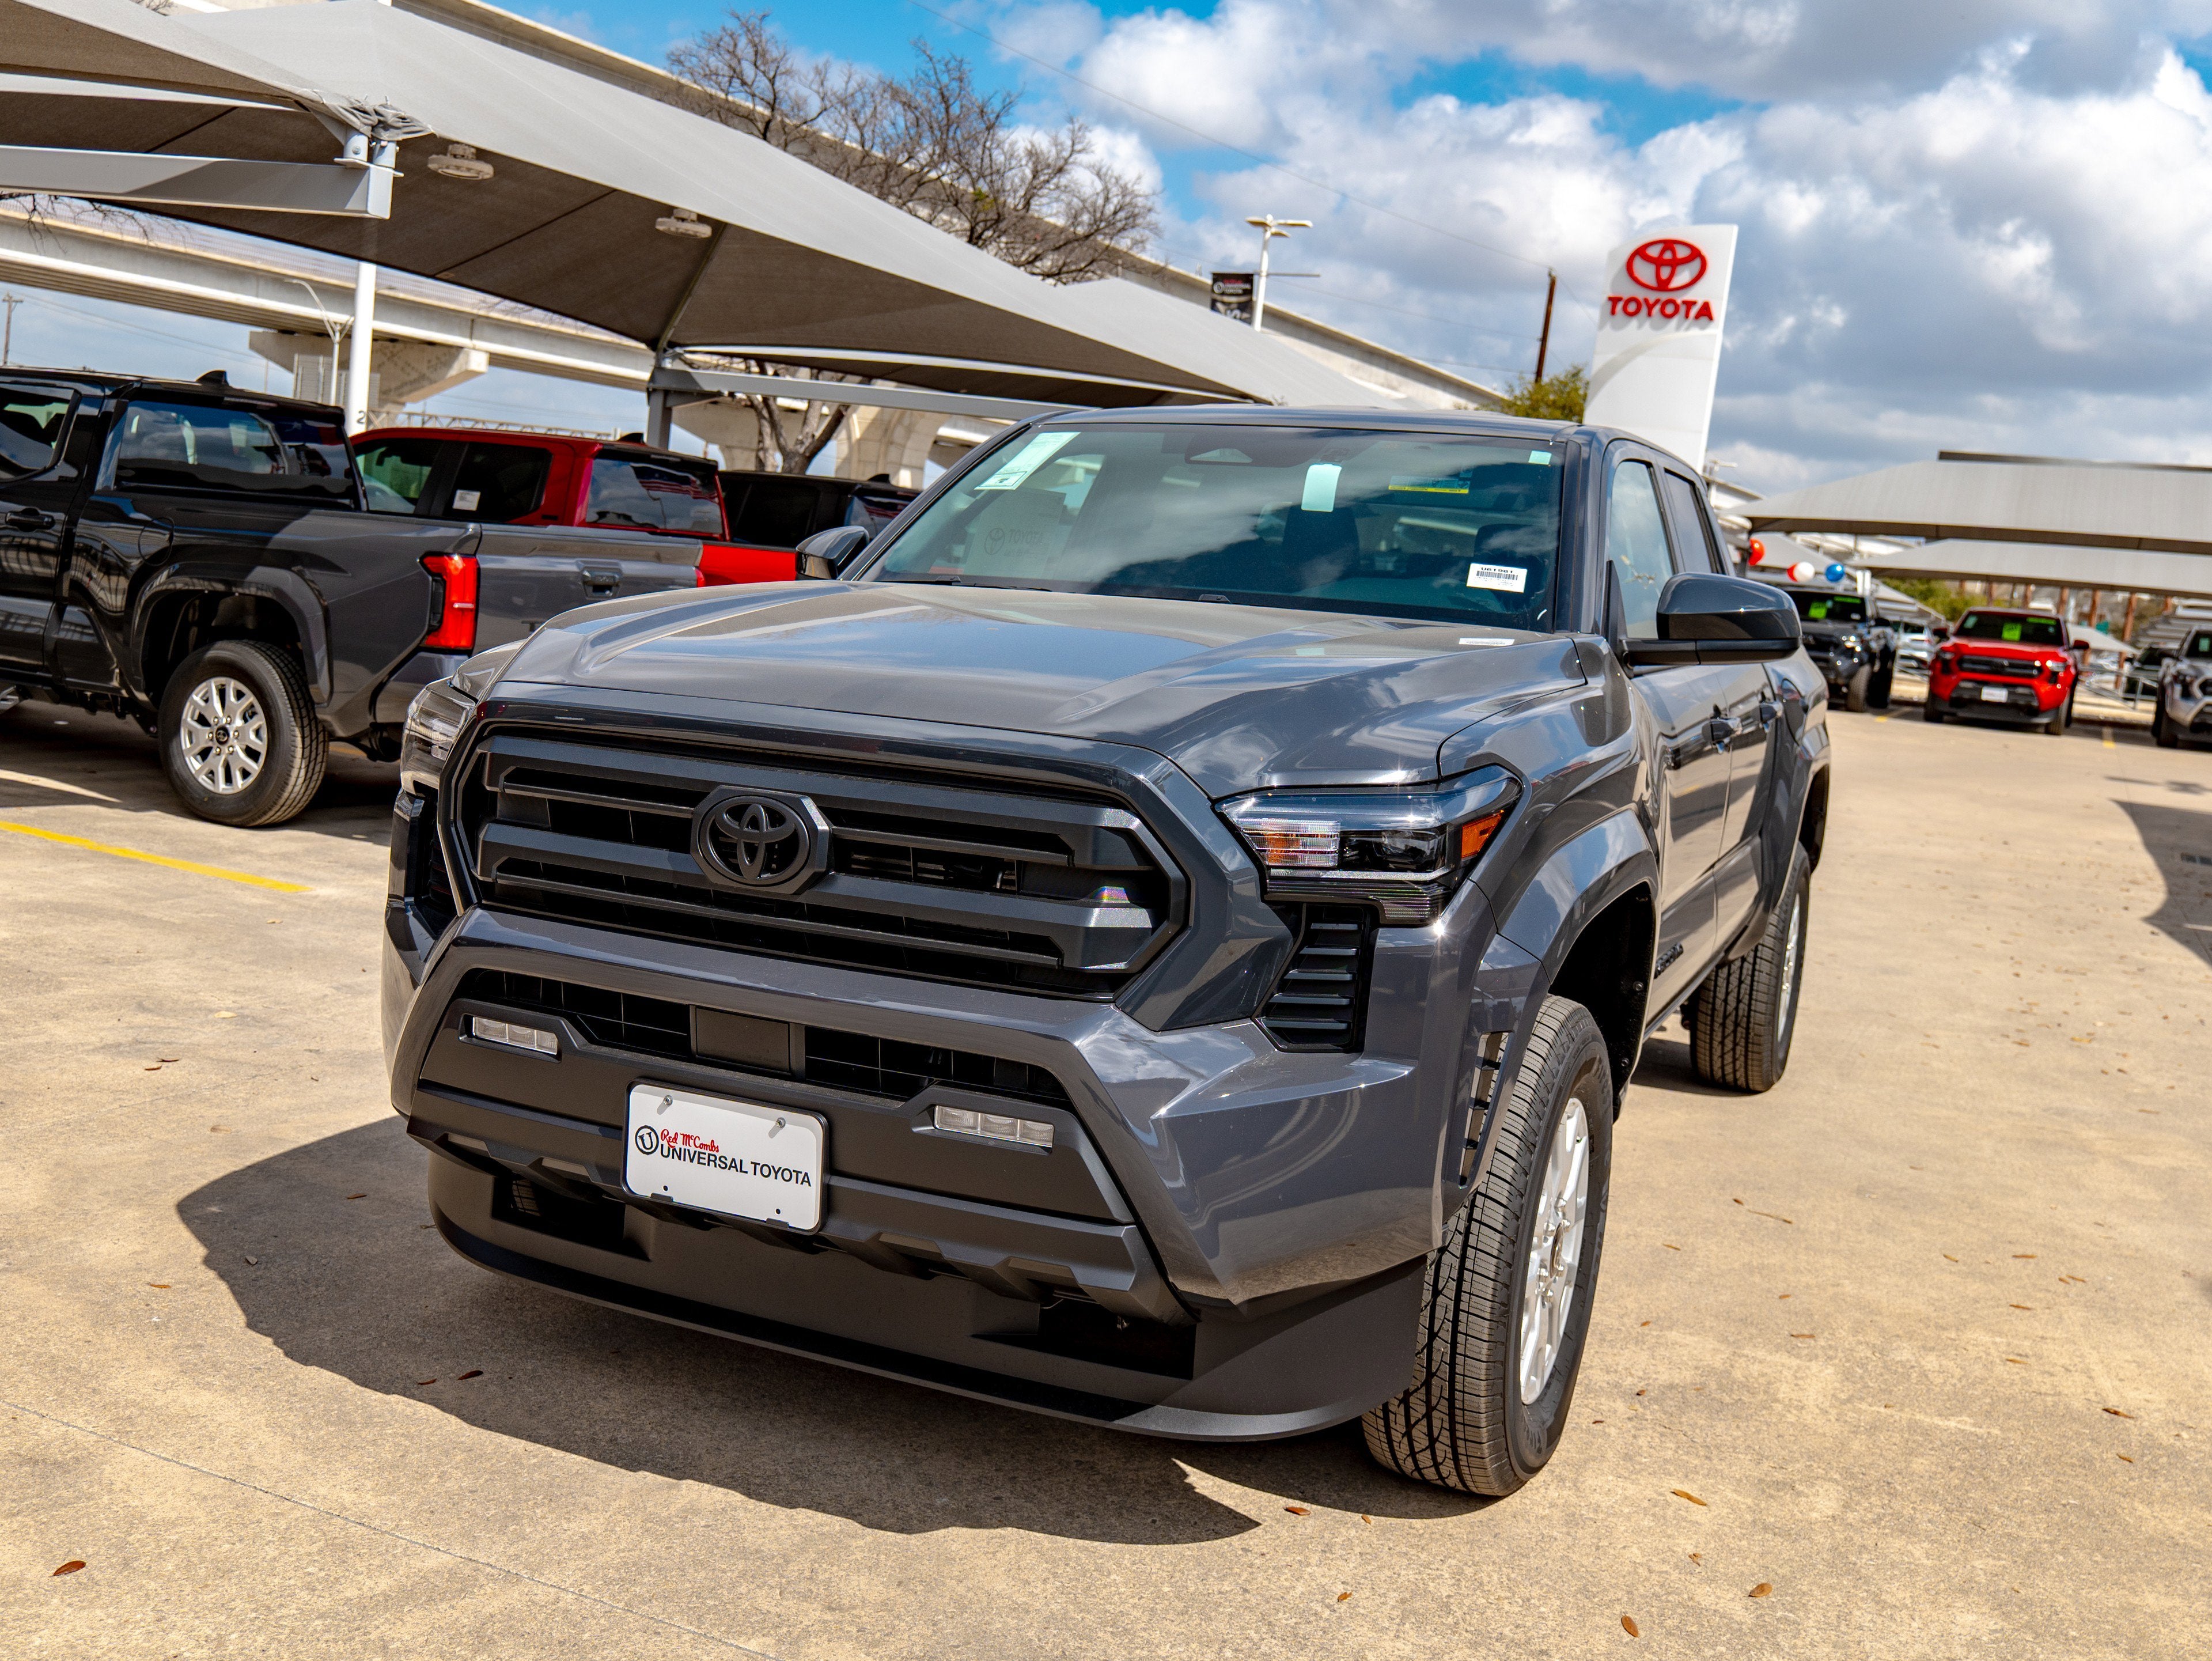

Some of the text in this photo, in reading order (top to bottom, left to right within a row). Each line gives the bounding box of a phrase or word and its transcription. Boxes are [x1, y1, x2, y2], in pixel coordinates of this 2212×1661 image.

[1608, 296, 1714, 320] TOYOTA
[660, 1129, 719, 1153] Red McCombs
[661, 1144, 812, 1187] UNIVERSAL TOYOTA
